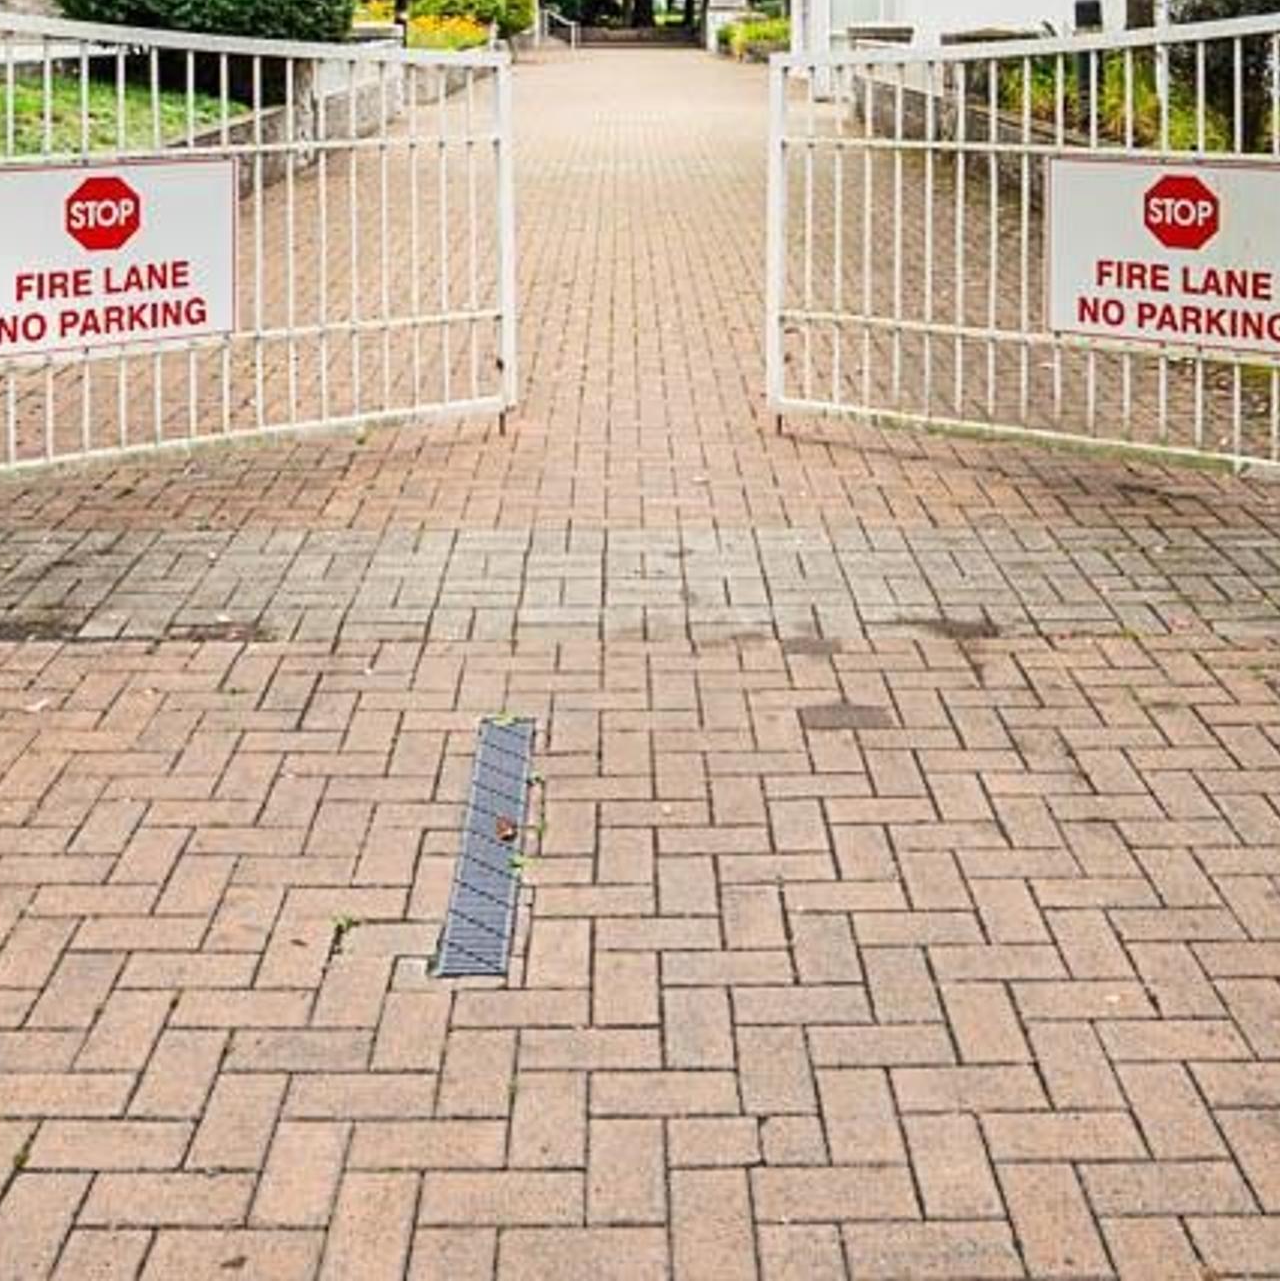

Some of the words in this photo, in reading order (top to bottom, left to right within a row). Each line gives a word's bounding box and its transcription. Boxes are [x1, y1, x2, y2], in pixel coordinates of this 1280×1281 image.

[70, 199, 134, 229] STOP
[1148, 198, 1213, 227] STOP
[15, 269, 93, 302] FIRE
[105, 260, 190, 294] LANE
[1096, 261, 1170, 292] FIRE
[1182, 266, 1273, 301] LANE
[60, 297, 207, 338] PARKING
[1077, 297, 1125, 325] NO
